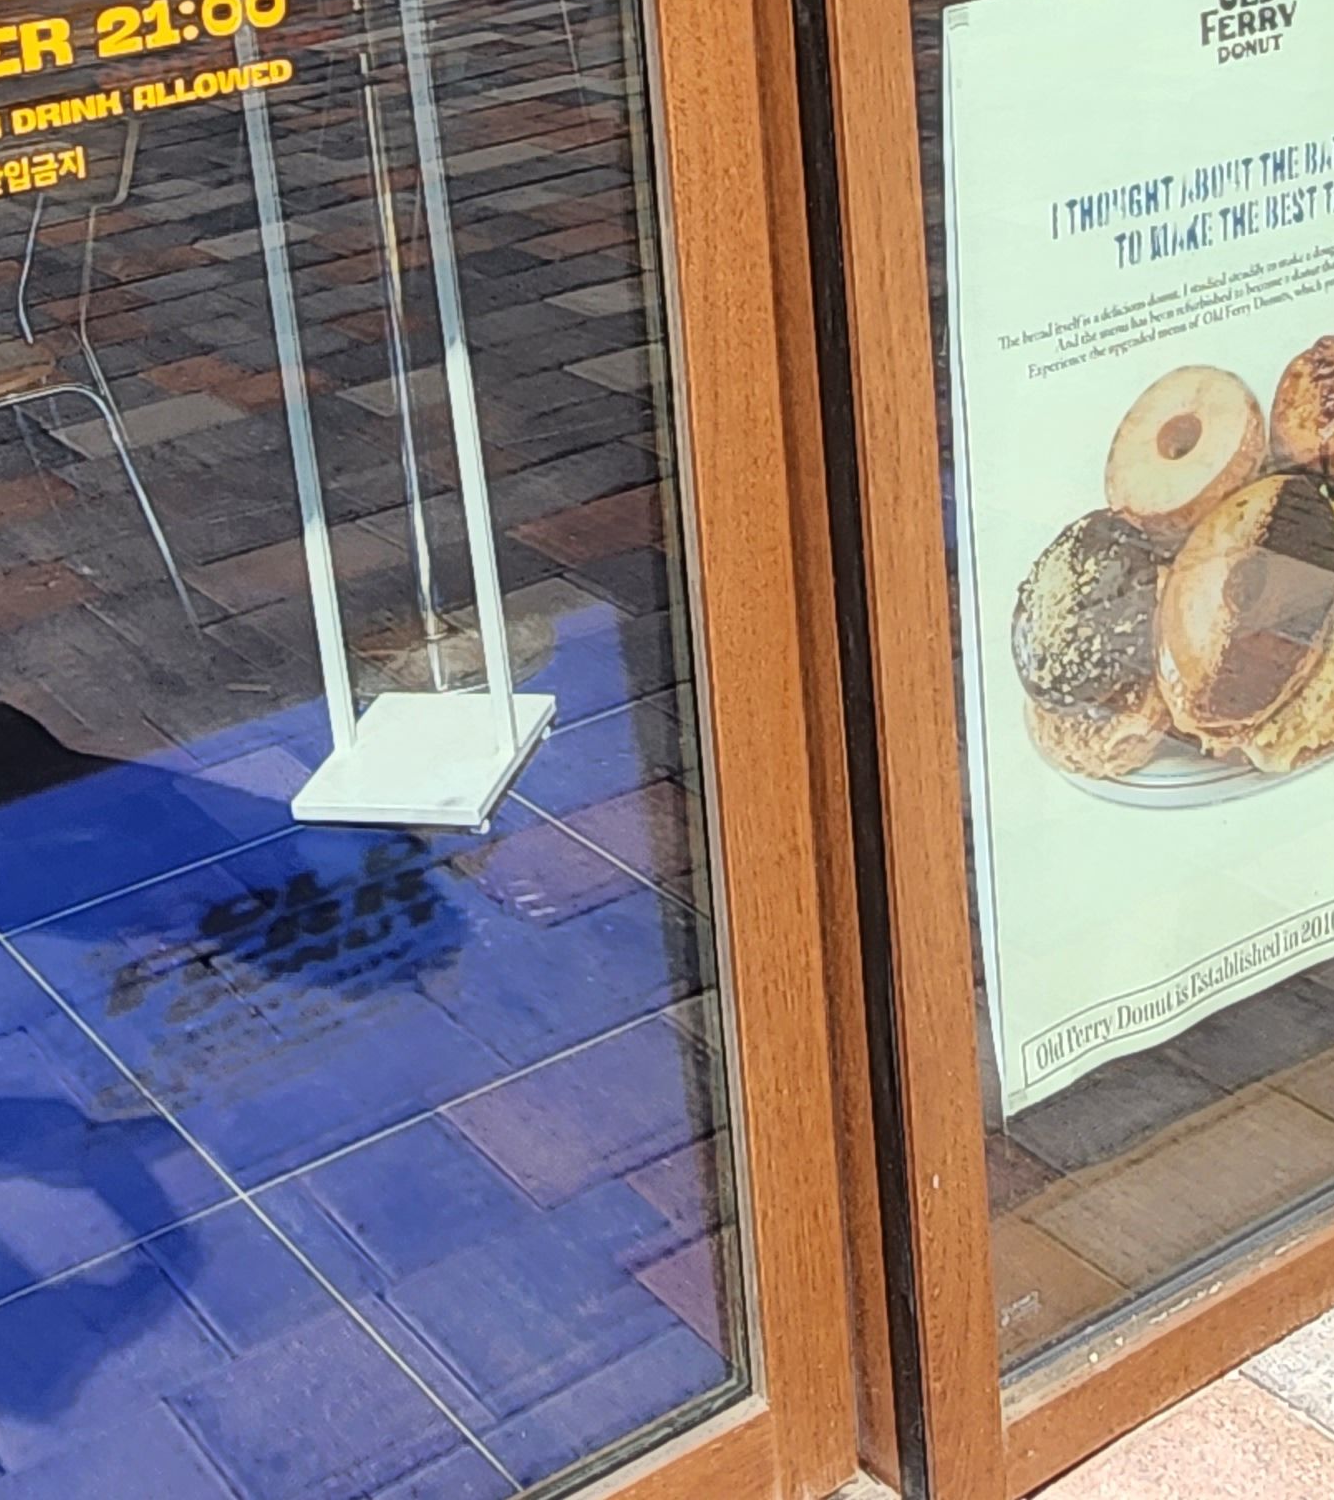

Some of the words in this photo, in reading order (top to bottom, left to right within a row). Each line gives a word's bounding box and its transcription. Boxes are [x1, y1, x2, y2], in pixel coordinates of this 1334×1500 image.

[1200, 0, 1298, 47] FERRY
[1217, 33, 1284, 65] DONUT
[11, 90, 121, 139] DRINK
[132, 57, 293, 112] ALLOWED
[1052, 202, 1058, 240] I
[1065, 175, 1174, 235] THOUGHT
[1180, 157, 1254, 208] ABOUT
[1259, 145, 1300, 187] THE
[1114, 230, 1142, 269] TO
[1150, 212, 1213, 261] MAKE
[1219, 200, 1259, 242] THE
[1266, 185, 1317, 230] BEST
[1202, 307, 1224, 324] Old
[1035, 1028, 1065, 1070] Old
[1065, 1014, 1113, 1055] Ferry
[1116, 992, 1174, 1030] Donut
[1174, 982, 1190, 1008] is
[1189, 929, 1281, 999] Established
[1283, 927, 1300, 950] in
